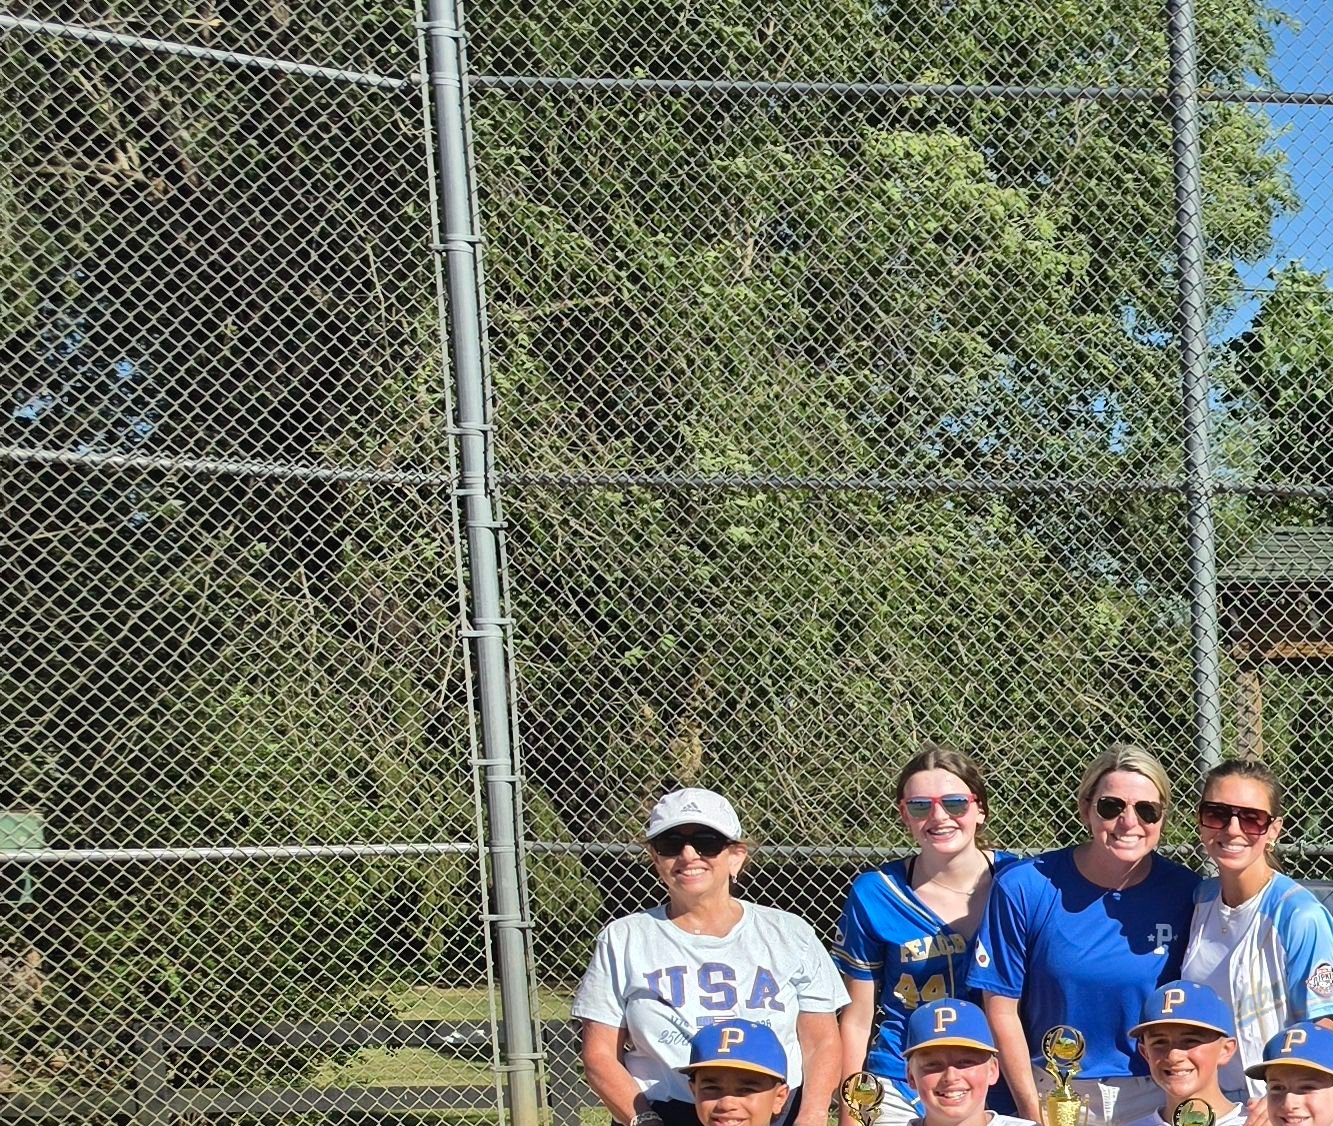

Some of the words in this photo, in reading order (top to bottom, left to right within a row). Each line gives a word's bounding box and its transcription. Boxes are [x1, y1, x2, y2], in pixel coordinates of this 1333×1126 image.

[1153, 923, 1174, 955] P
[643, 961, 786, 1013] USA
[1161, 988, 1186, 1014] P
[933, 1006, 958, 1033] P
[717, 1026, 746, 1053] P
[1280, 1028, 1308, 1053] P
